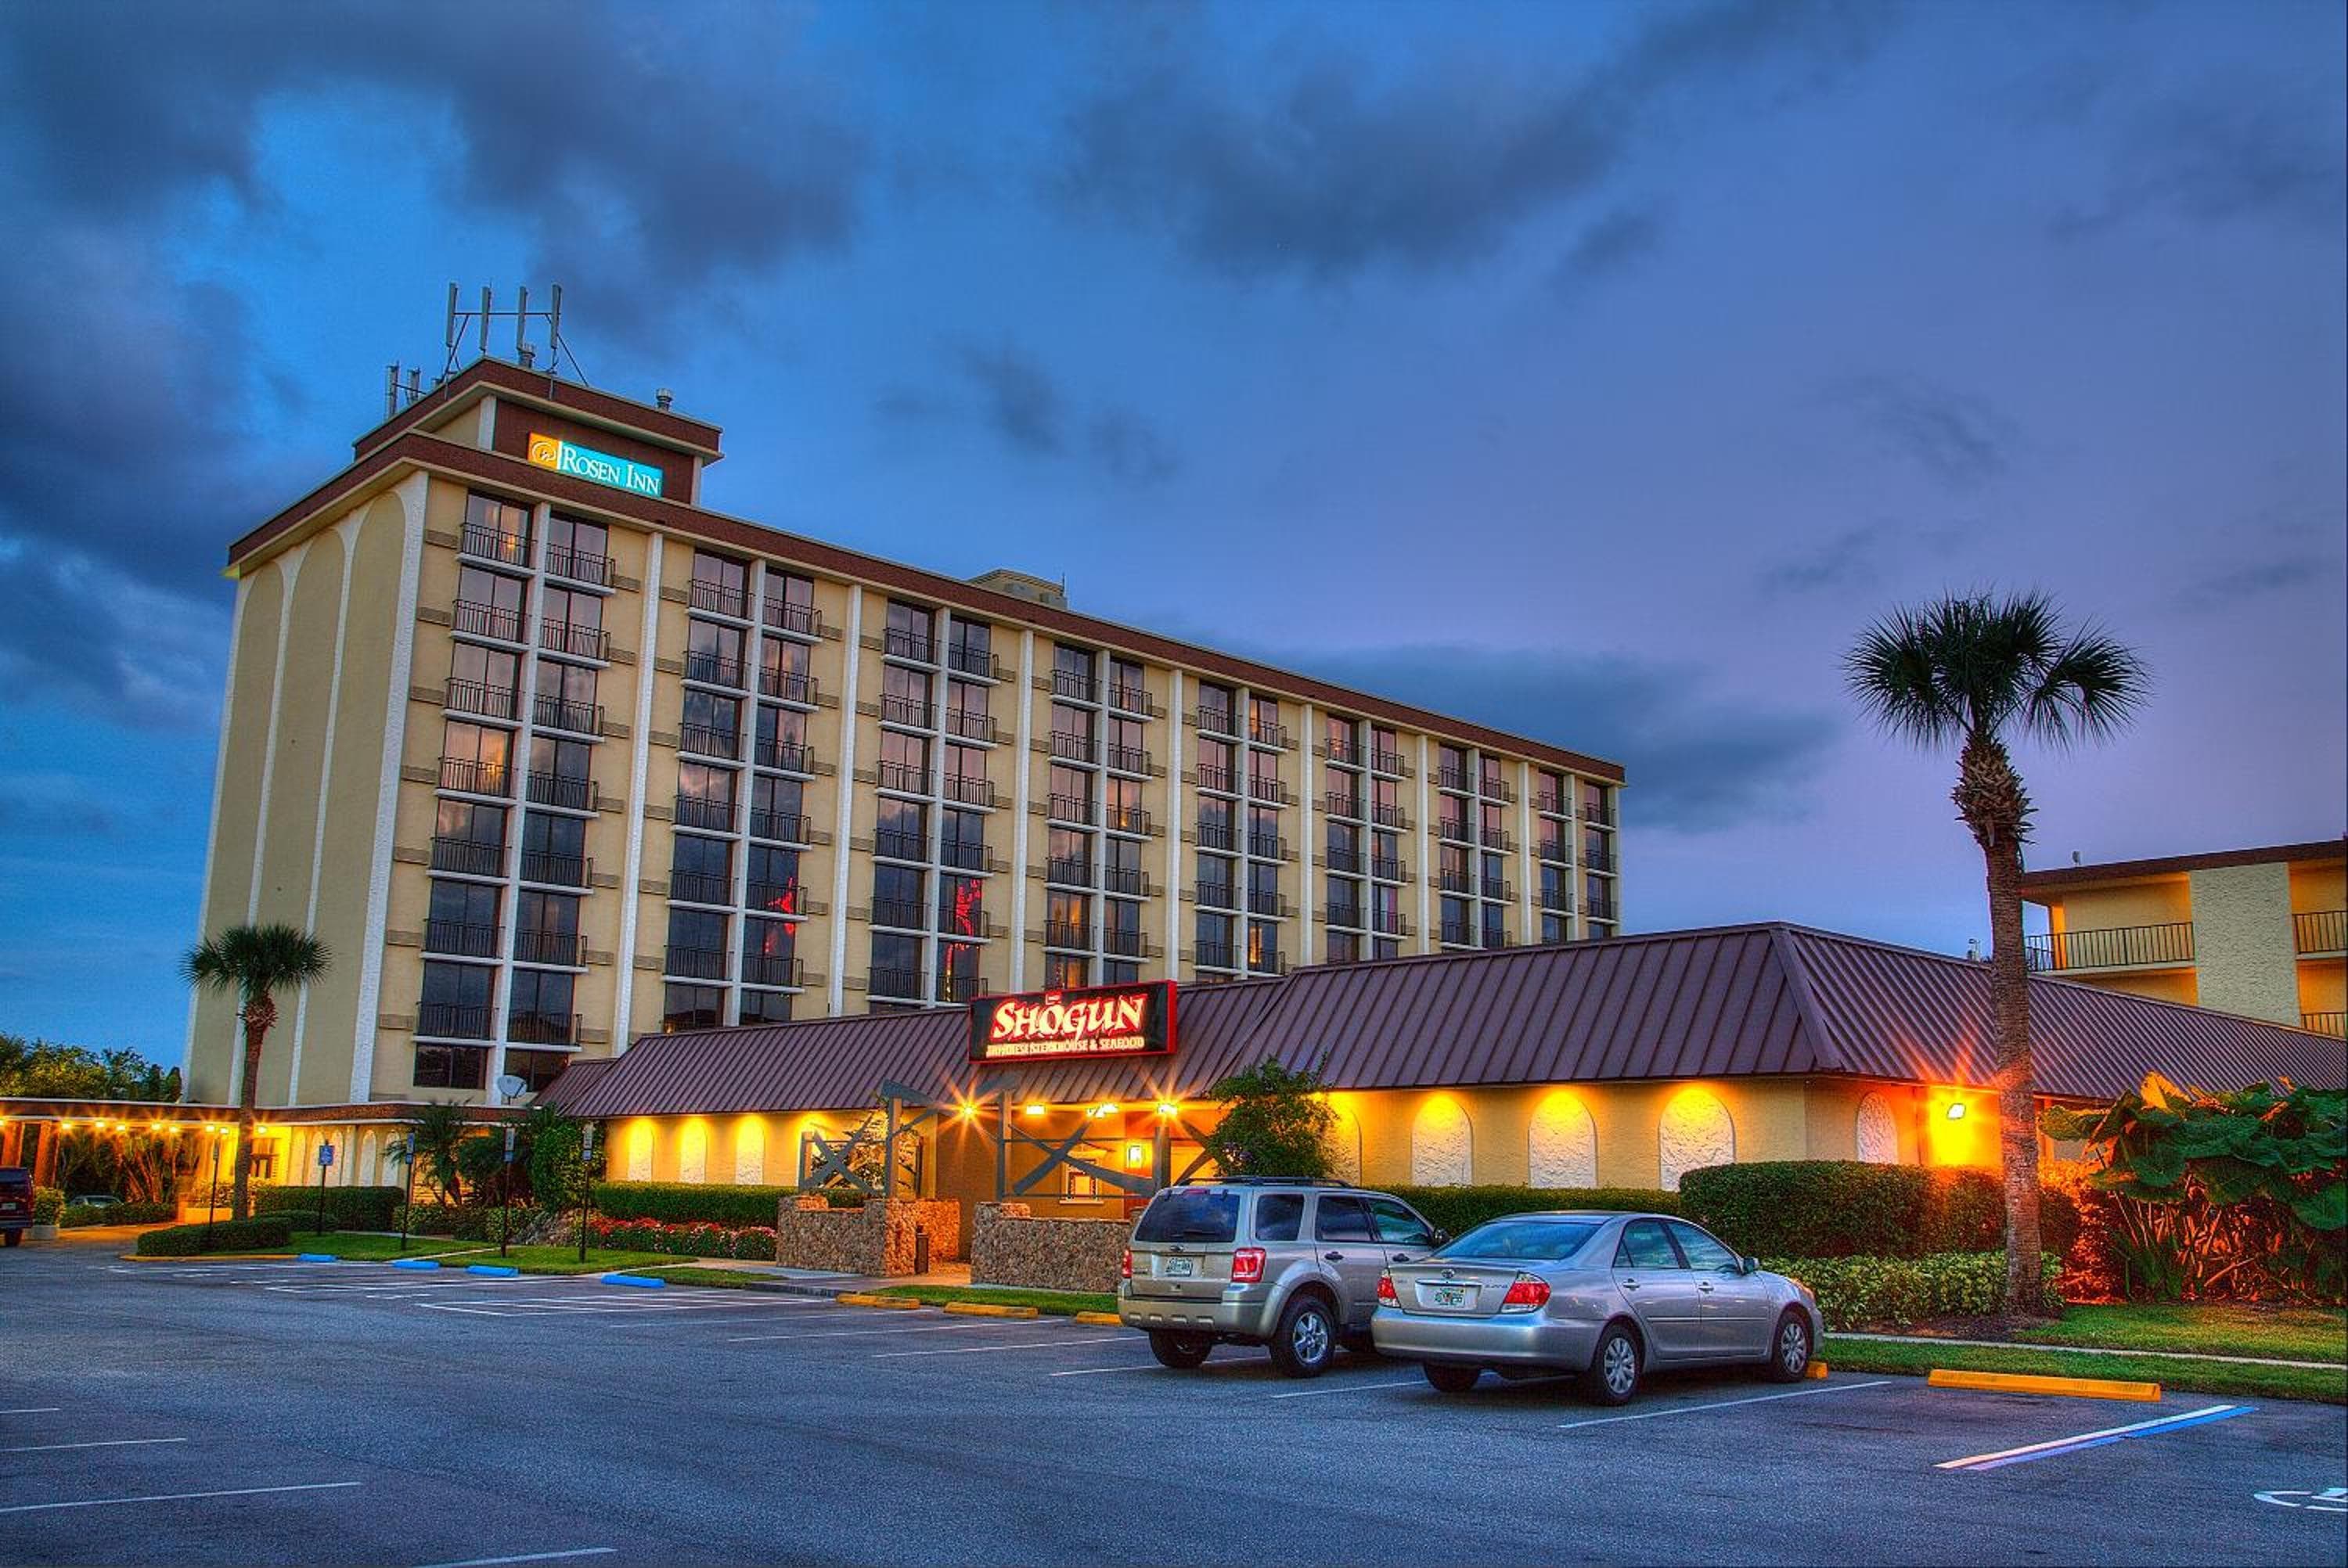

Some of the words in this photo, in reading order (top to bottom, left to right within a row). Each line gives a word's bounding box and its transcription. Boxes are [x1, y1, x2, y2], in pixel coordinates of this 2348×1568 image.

[562, 446, 621, 483] ROSEN
[625, 462, 660, 494] INN
[1089, 1038, 1098, 1051] &
[1099, 1037, 1145, 1051] SEAFOOD
